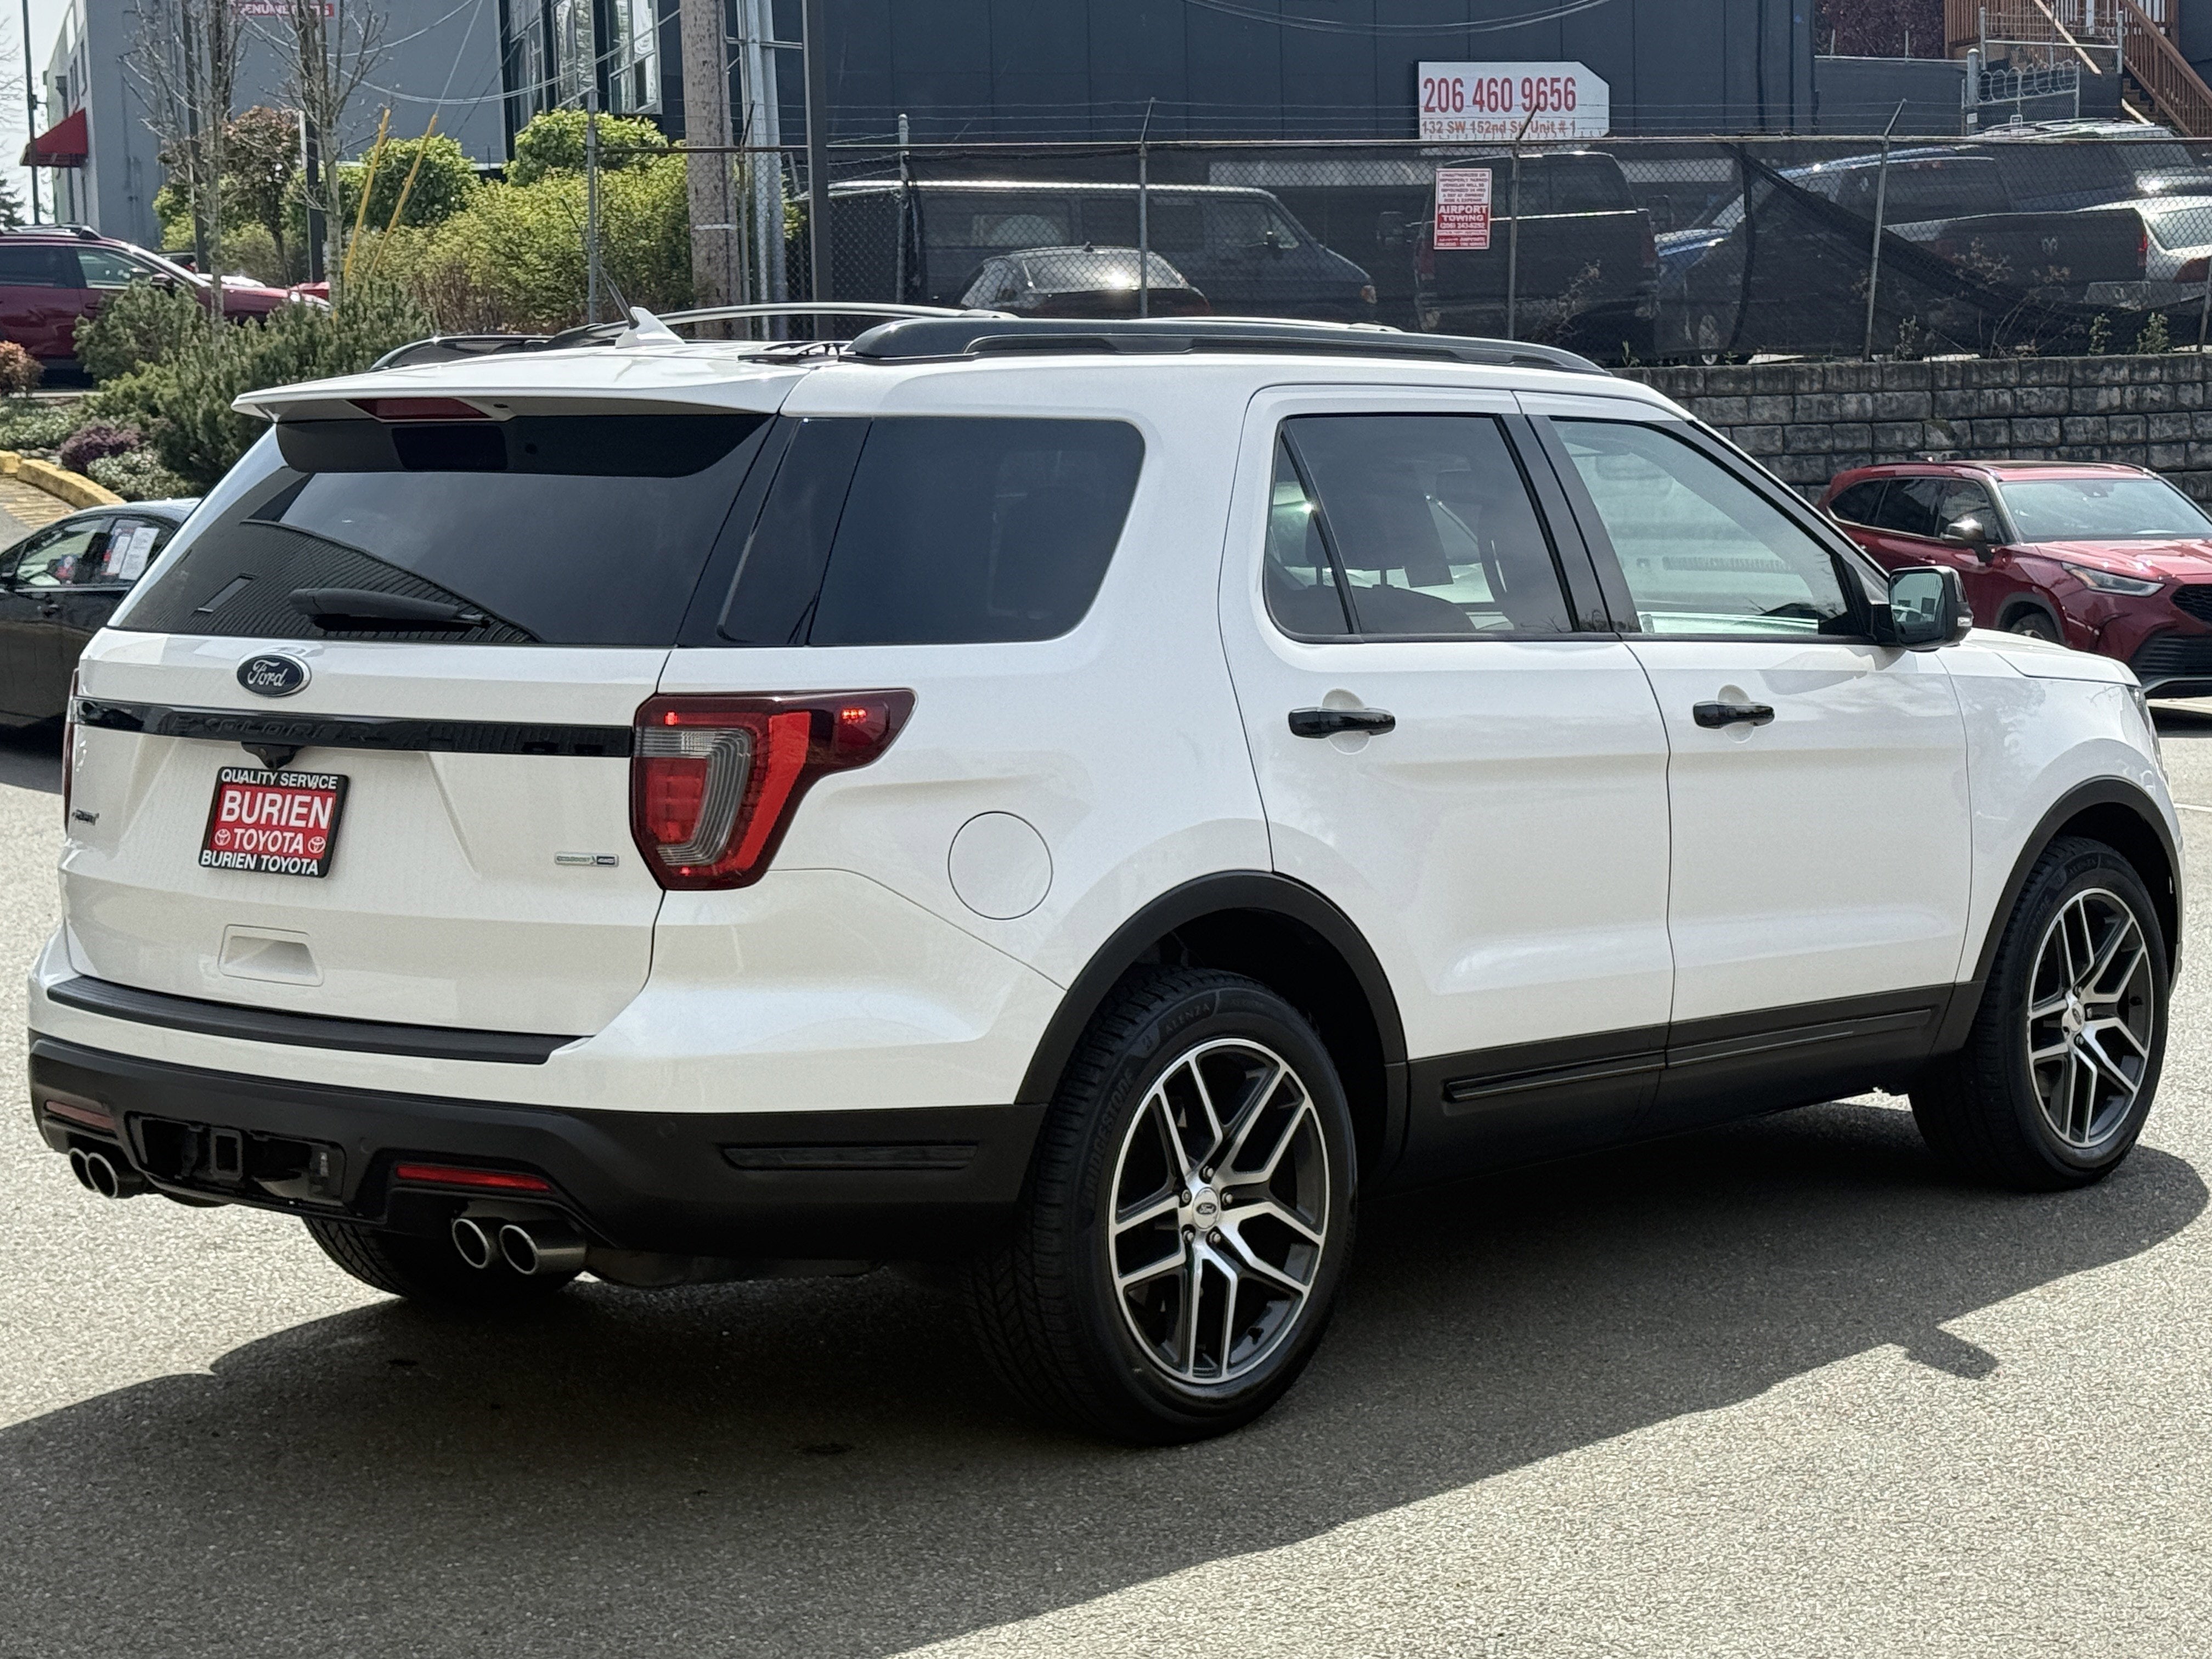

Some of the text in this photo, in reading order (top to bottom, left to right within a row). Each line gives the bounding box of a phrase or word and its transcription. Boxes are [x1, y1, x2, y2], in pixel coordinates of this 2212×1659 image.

[240, 3, 290, 15] ENUNE
[1423, 77, 1577, 112] 206 460 9656
[1422, 120, 1443, 134] 132
[1447, 120, 1466, 134] SW
[1470, 120, 1506, 134] 152nd
[1530, 120, 1555, 133] Unit
[1438, 205, 1488, 214] AIRPORT
[247, 659, 289, 686] Ford
[221, 769, 338, 789] QUALITY SERVICE
[221, 789, 333, 829] BURIEN
[234, 828, 303, 854] TOYOTA
[201, 850, 319, 875] BURIEN TOYOTA
